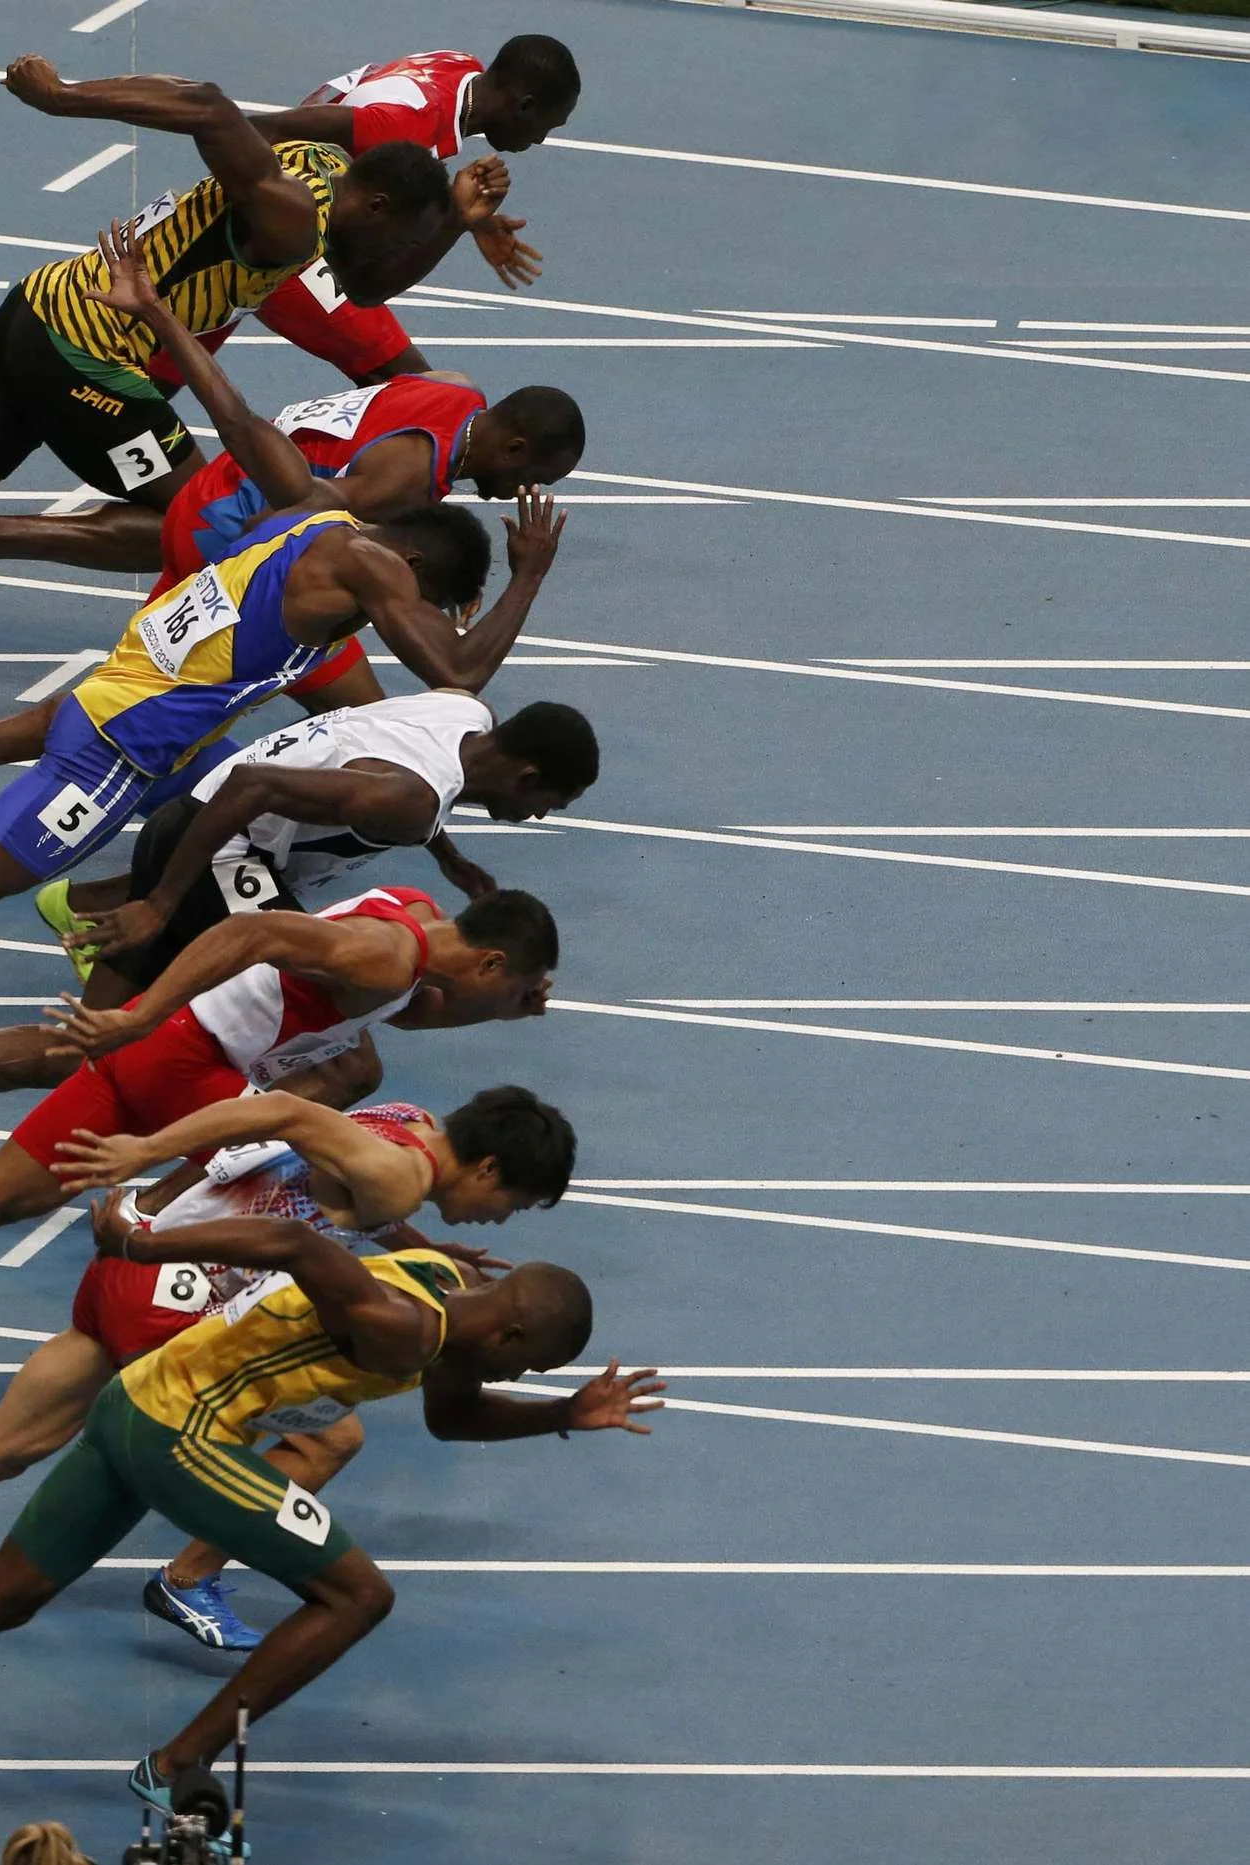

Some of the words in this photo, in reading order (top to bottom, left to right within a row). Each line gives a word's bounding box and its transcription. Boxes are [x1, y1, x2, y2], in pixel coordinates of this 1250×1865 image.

[316, 265, 344, 299] 2
[70, 385, 125, 416] JAM
[125, 447, 155, 478] 3
[200, 575, 230, 621] TDK
[163, 594, 199, 645] 166
[154, 648, 176, 674] 2013
[265, 733, 299, 758] 4
[56, 801, 90, 832] 5
[233, 864, 262, 899] 6
[170, 1268, 198, 1301] 8
[292, 1497, 323, 1527] 9
